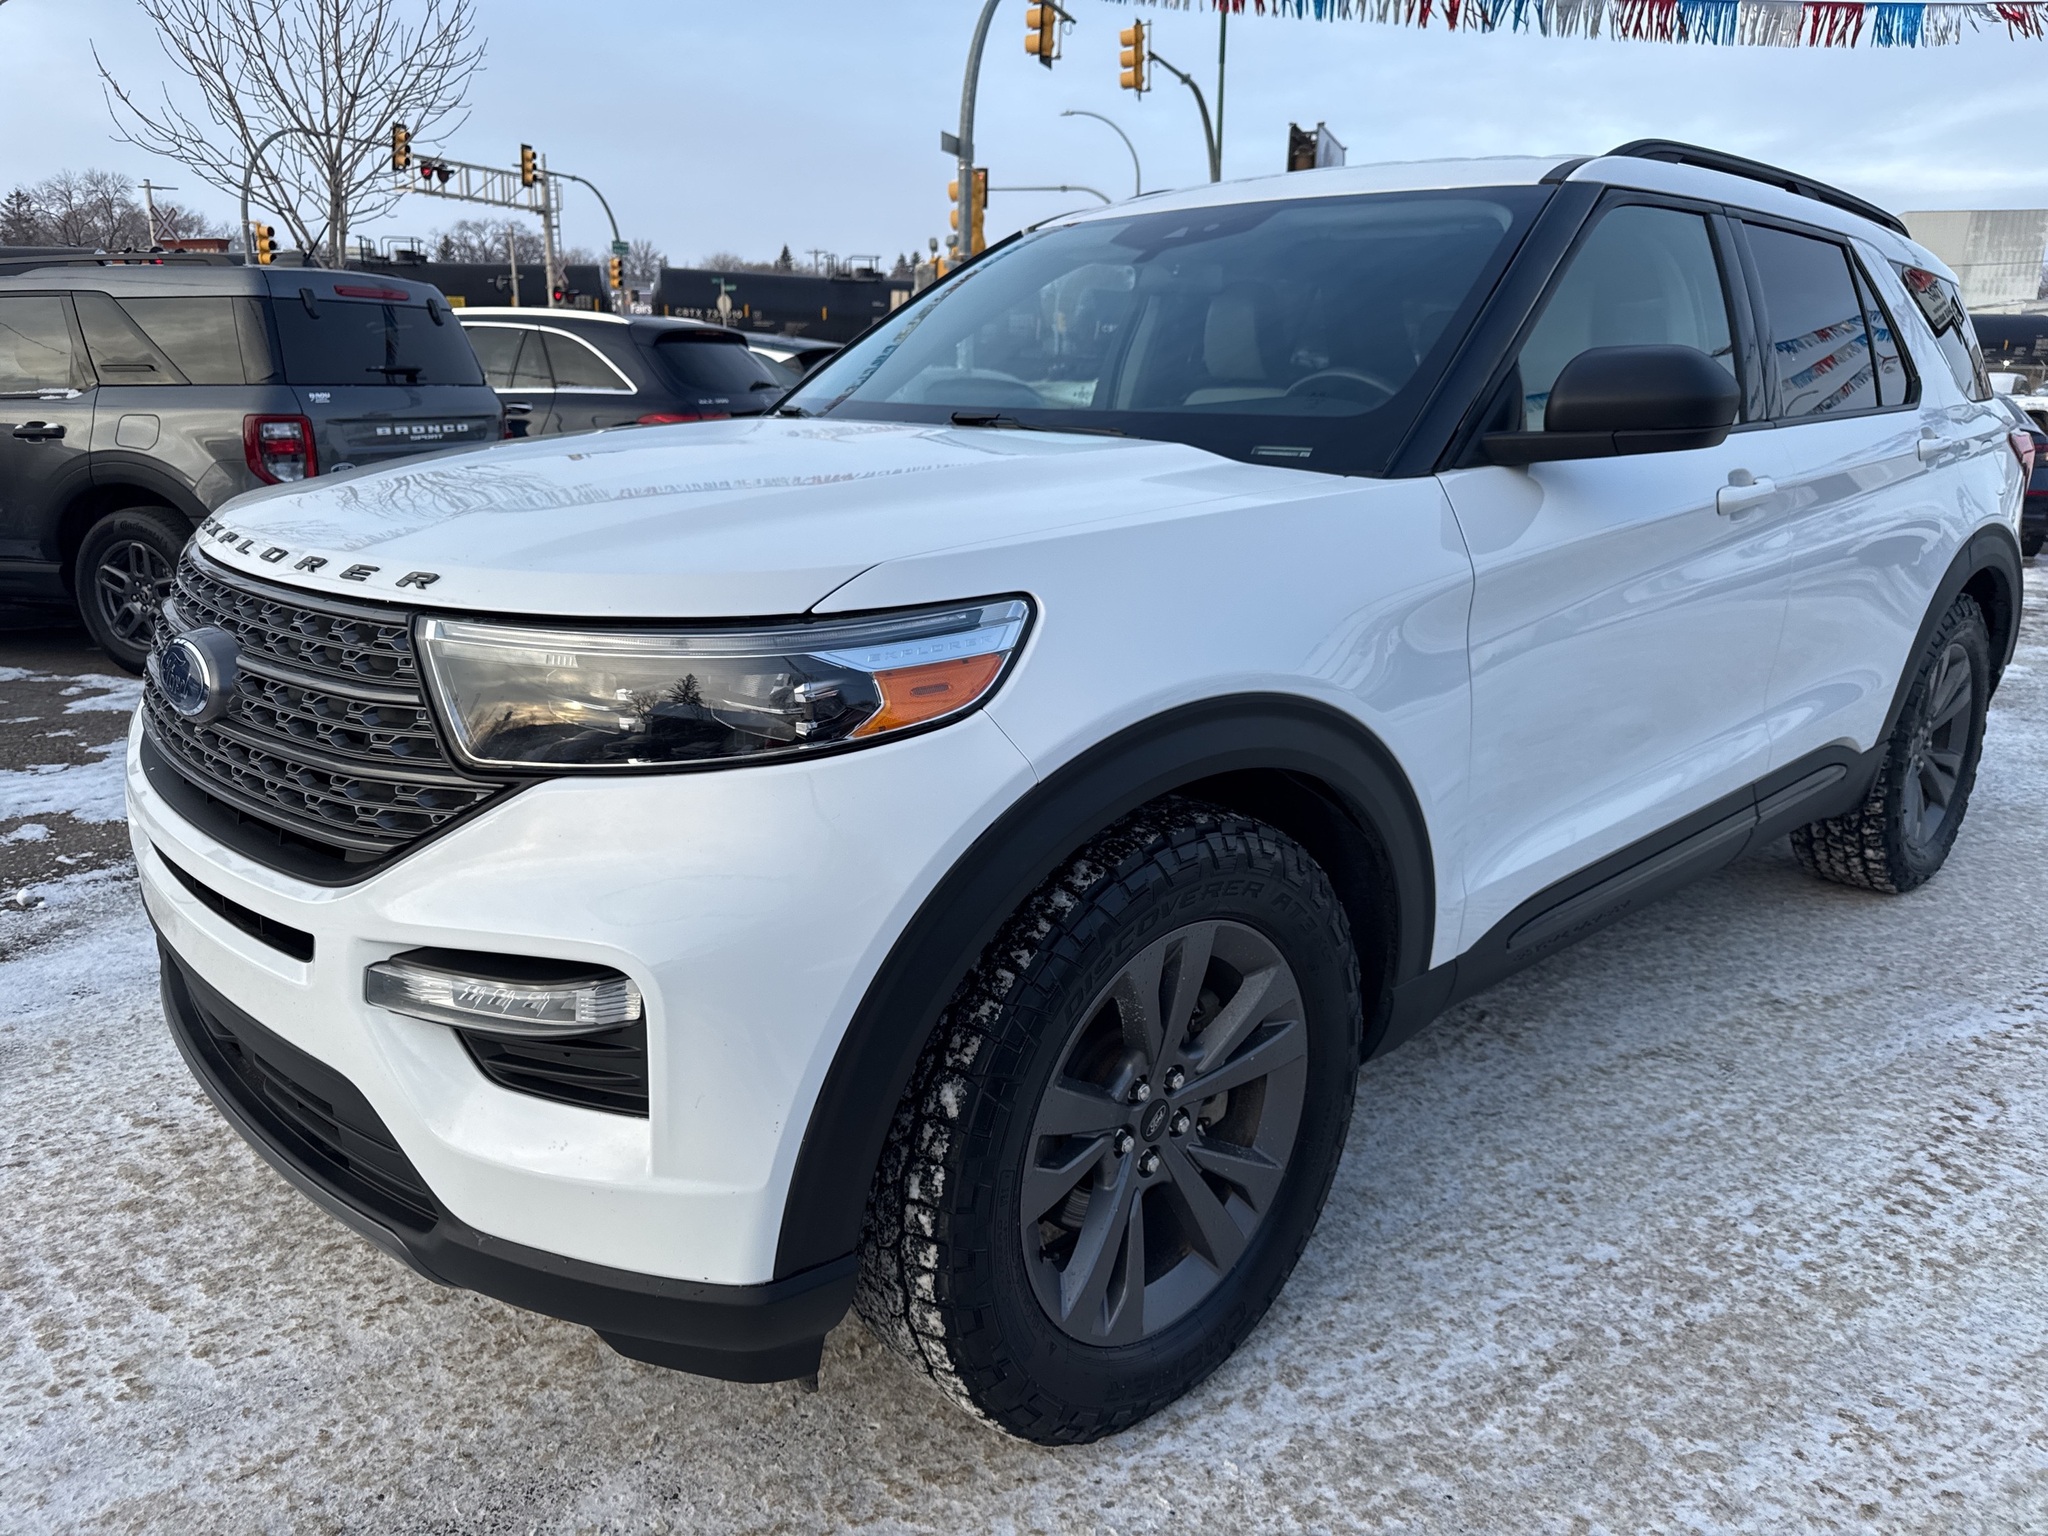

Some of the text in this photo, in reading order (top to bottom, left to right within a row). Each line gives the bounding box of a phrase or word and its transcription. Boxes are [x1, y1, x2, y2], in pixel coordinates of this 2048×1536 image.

[376, 424, 469, 436] BRONCO
[410, 433, 445, 442] SPORT
[200, 516, 441, 590] EXPLORER
[867, 636, 993, 663] EXPLORER
[1063, 879, 1266, 1026] DISCOVERER
